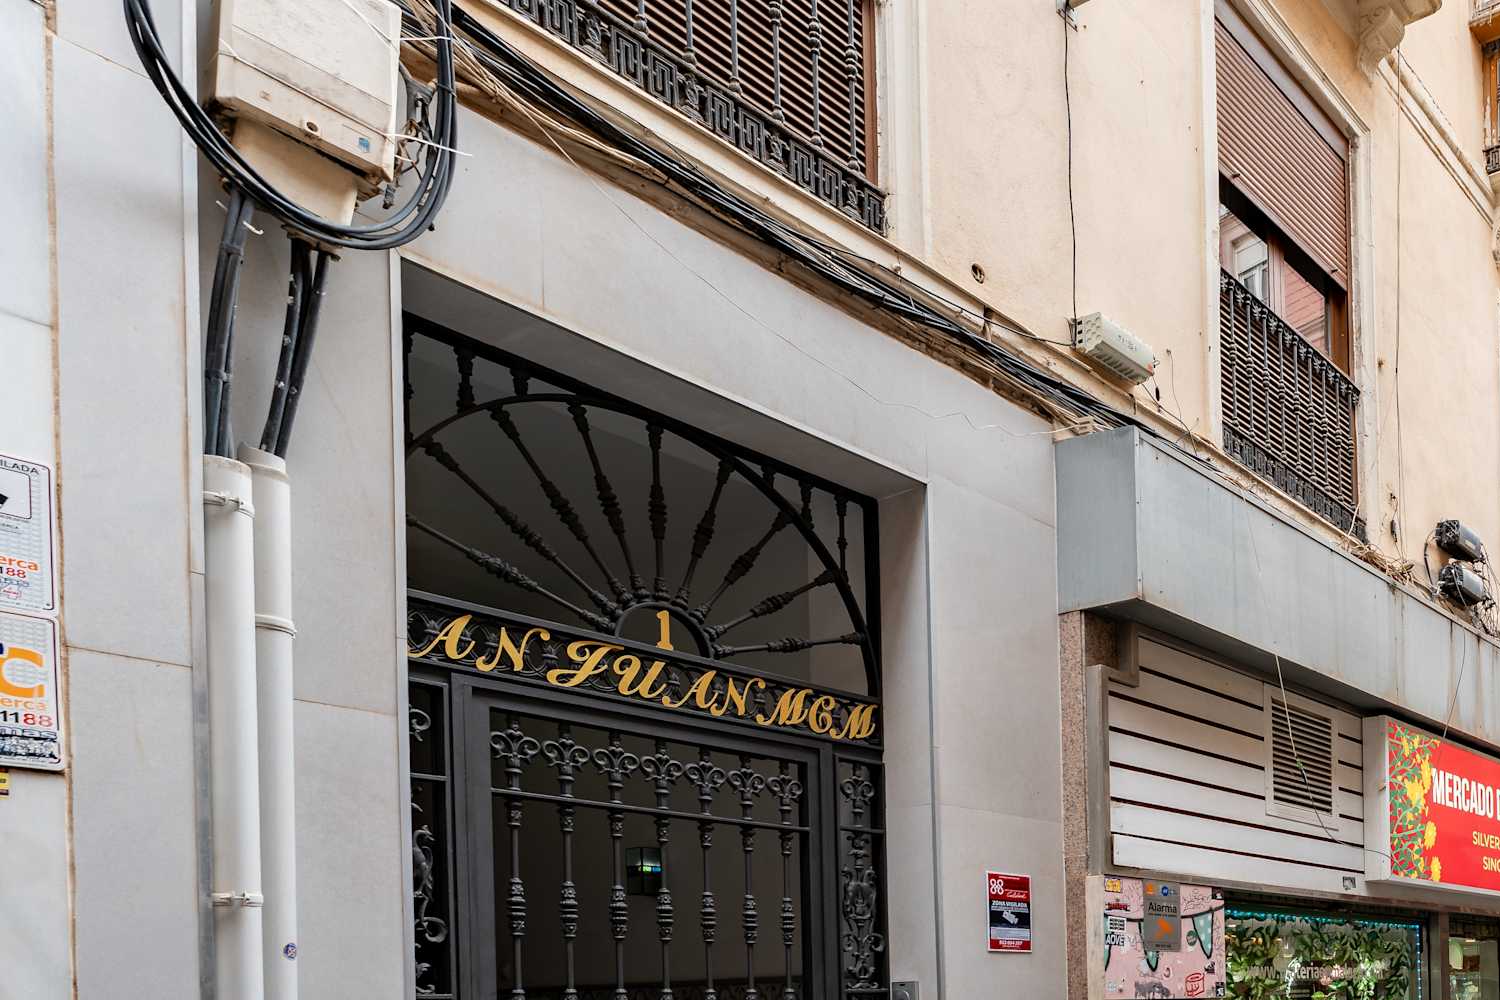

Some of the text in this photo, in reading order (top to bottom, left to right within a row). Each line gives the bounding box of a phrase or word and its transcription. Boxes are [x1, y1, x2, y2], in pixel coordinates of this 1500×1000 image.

[655, 610, 674, 651] 1
[546, 640, 766, 718] JUAN
[1432, 768, 1494, 819] MERCADO
[1472, 831, 1500, 850] SILVER
[1148, 902, 1177, 913] Alarma
